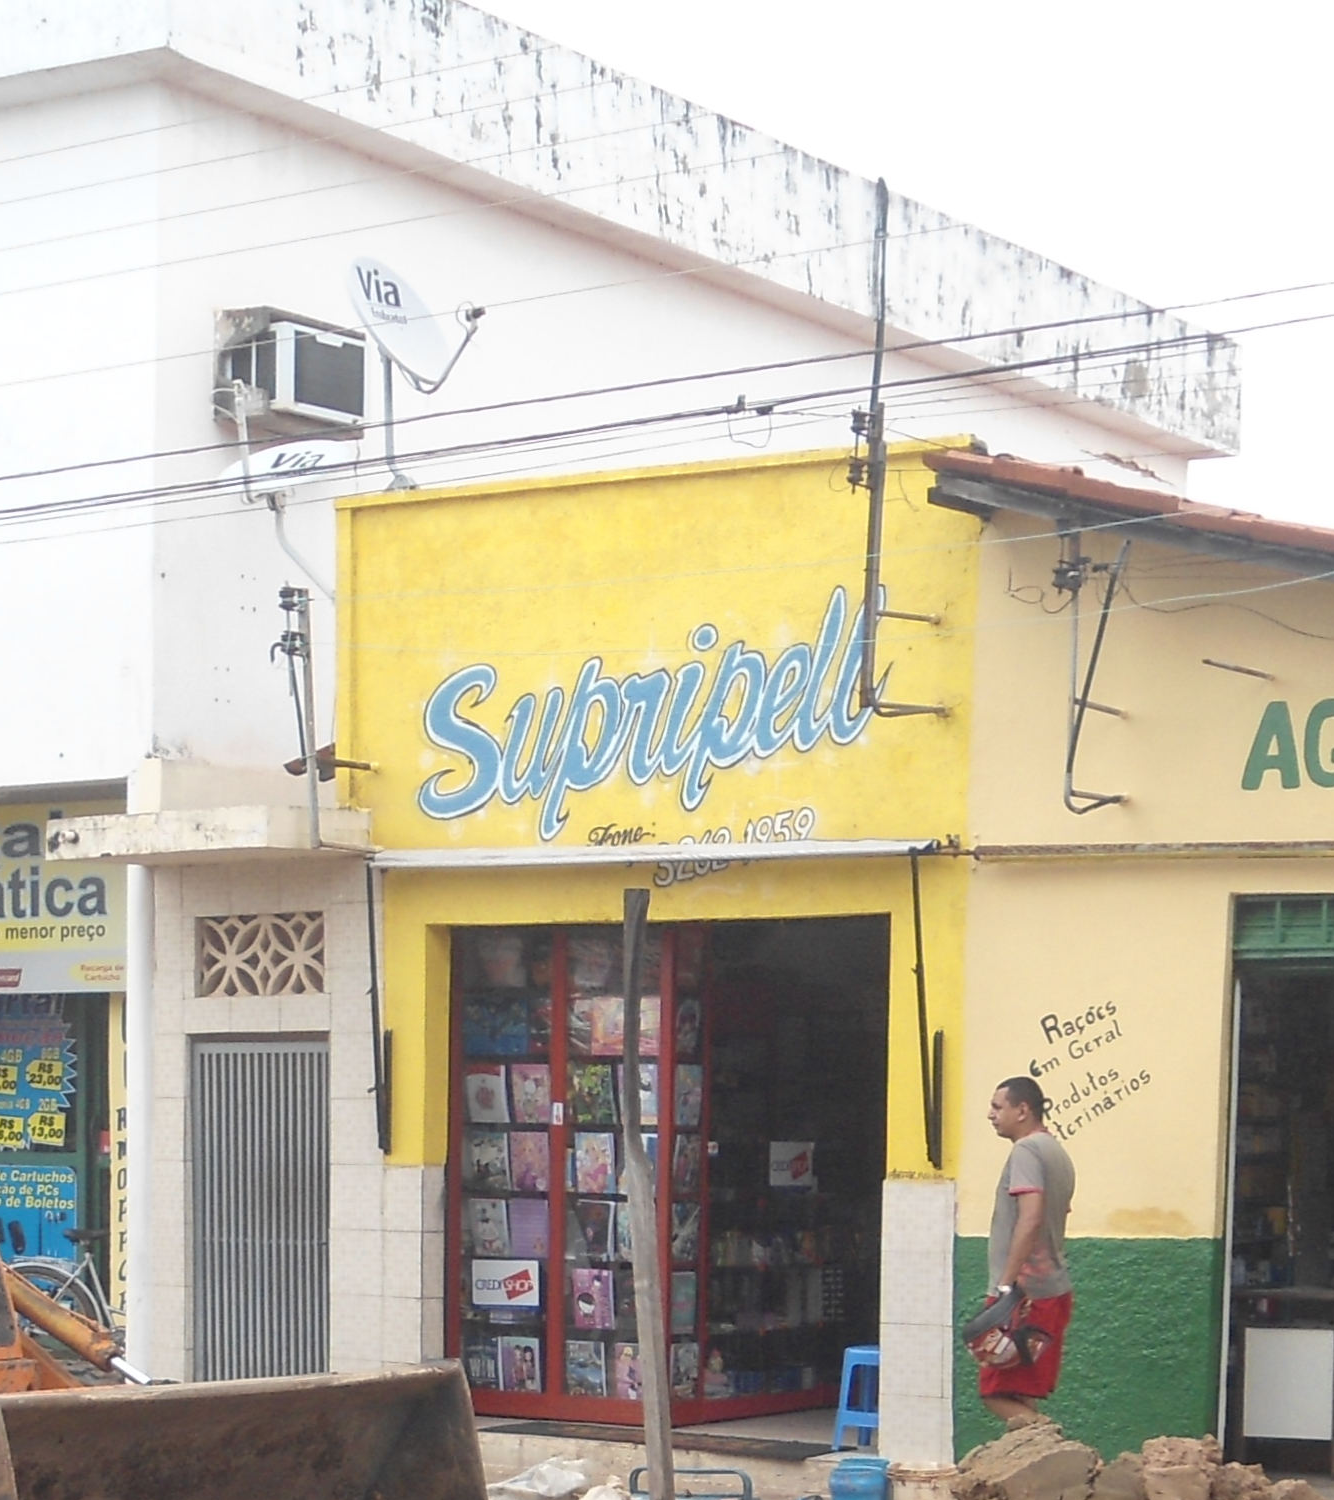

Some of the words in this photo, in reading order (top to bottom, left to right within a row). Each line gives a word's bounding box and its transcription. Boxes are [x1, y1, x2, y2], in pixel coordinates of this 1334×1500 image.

[356, 265, 401, 307] Via
[270, 451, 325, 470] Via
[418, 584, 894, 841] Supripell
[4, 924, 56, 940] menor
[59, 922, 106, 943] preço
[1040, 1000, 1117, 1045] Rações
[1029, 1056, 1061, 1078] Em
[1068, 1019, 1123, 1060] Geral
[0, 1049, 23, 1063] 4GB
[37, 1063, 54, 1074] R$
[29, 1073, 62, 1086] 23,00
[1043, 1068, 1120, 1121] Produtos
[38, 1097, 58, 1111] 2GB
[1053, 1069, 1152, 1141] terinários
[0, 1118, 16, 1130] R$
[39, 1116, 55, 1127] R$
[31, 1126, 64, 1139] 13,00
[11, 1170, 74, 1184] Cartuchos
[19, 1184, 33, 1196] de
[36, 1185, 60, 1196] PCs
[5, 1196, 21, 1208] de
[25, 1197, 75, 1210] Boletos
